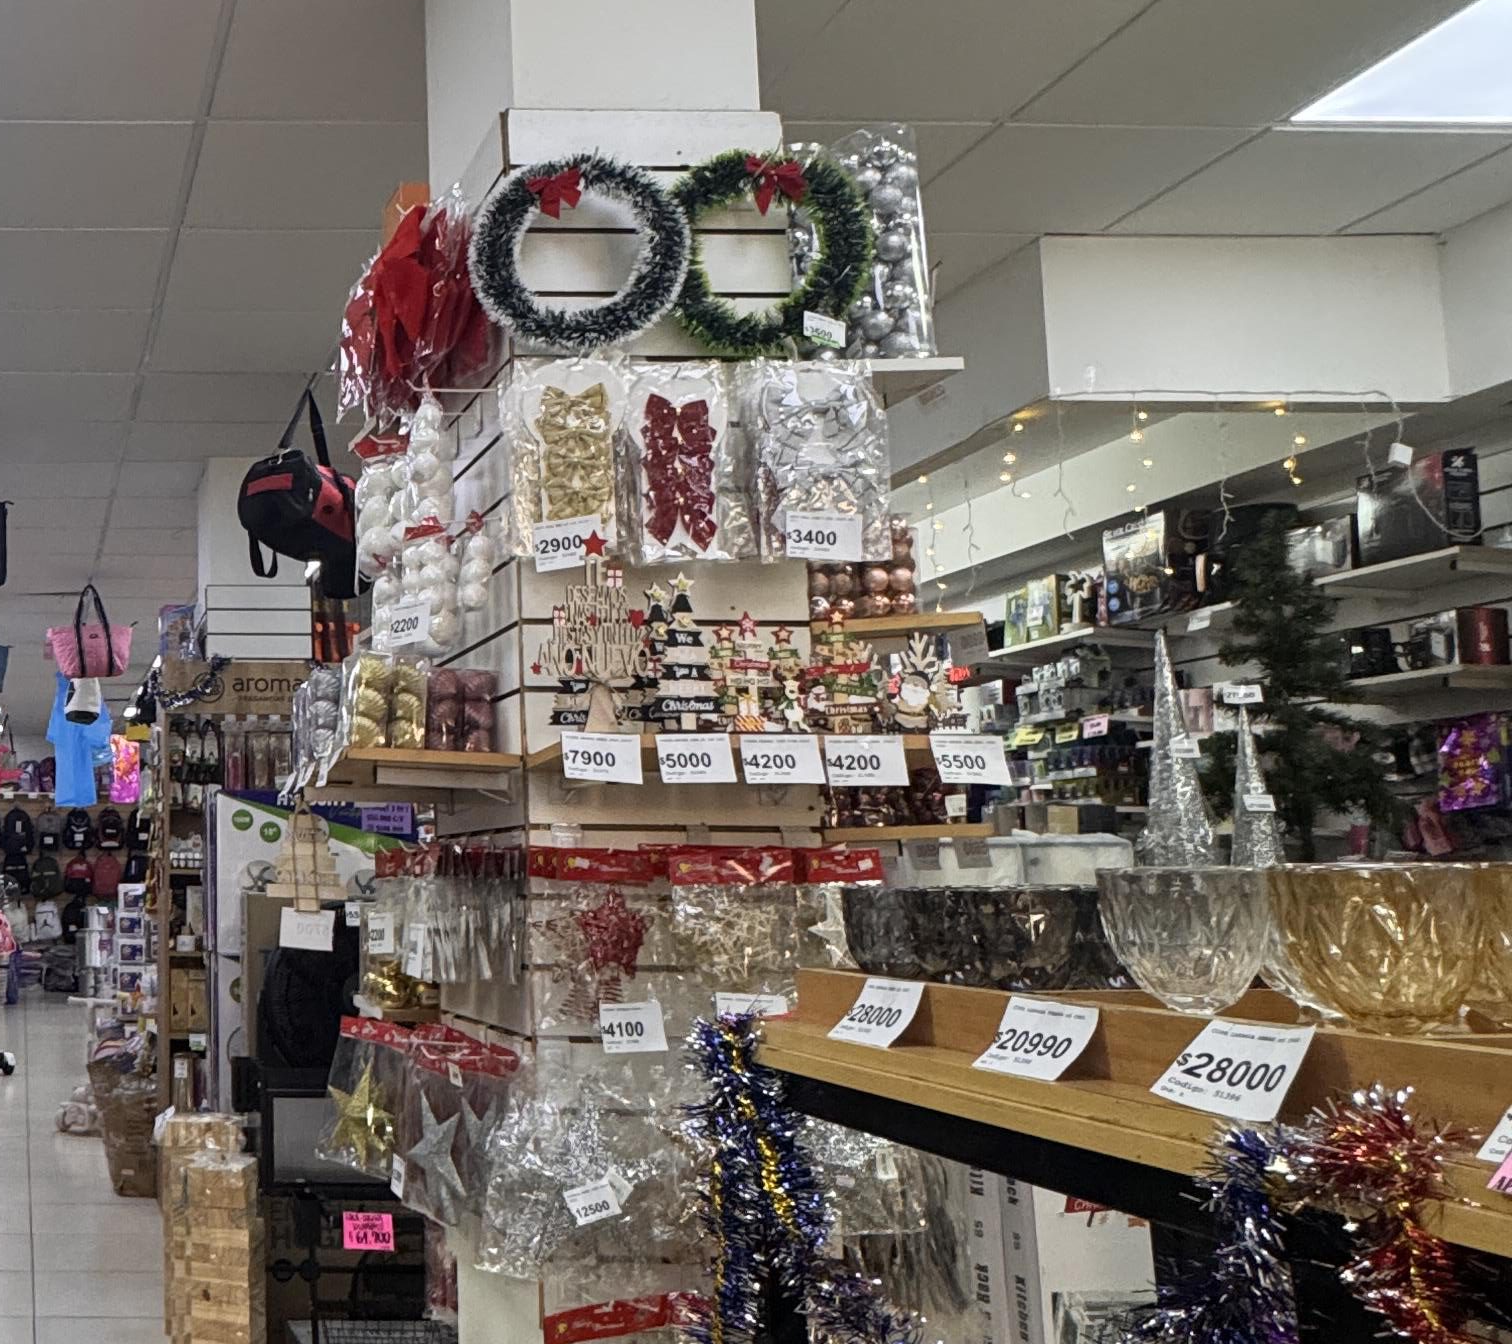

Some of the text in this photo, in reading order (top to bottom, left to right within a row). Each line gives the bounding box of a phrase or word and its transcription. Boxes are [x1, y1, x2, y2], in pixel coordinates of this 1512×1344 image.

[535, 534, 583, 554] $2900
[787, 529, 837, 546] $3400
[564, 750, 616, 767] $7900
[660, 752, 711, 768] $5000
[744, 754, 796, 769] $4200
[827, 754, 880, 770] $4200
[938, 754, 986, 770] $5500
[847, 1004, 902, 1028] $28000
[601, 1021, 644, 1037] $4100
[993, 1028, 1072, 1059] $20990
[1176, 1052, 1287, 1093] $28000
